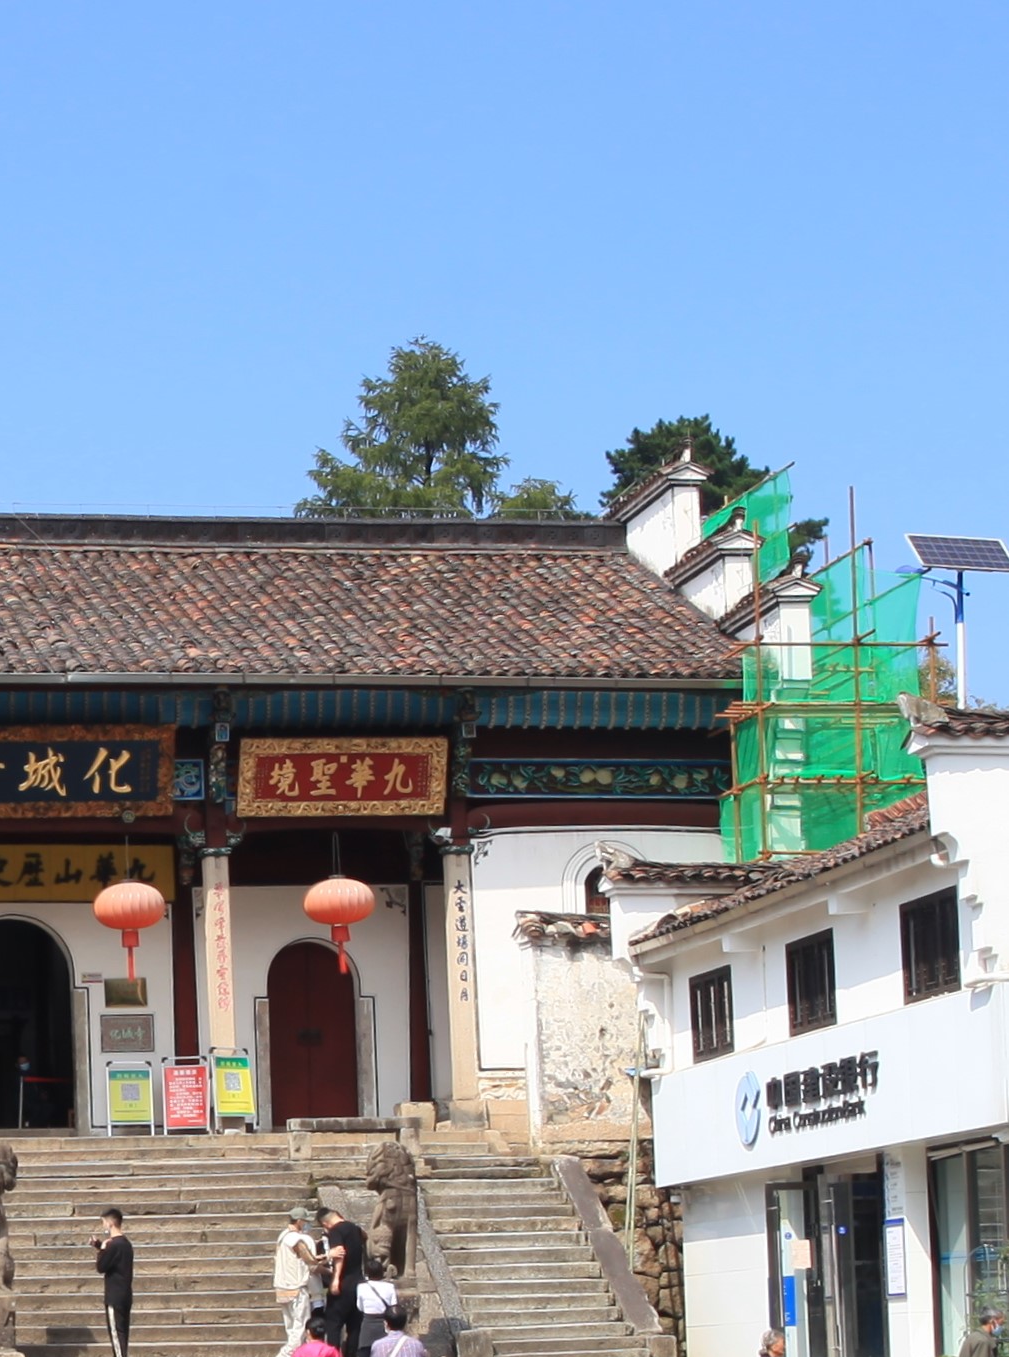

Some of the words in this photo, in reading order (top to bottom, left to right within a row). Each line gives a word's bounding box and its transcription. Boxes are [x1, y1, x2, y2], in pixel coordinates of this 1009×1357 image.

[765, 1050, 879, 1110] 中国建设银行
